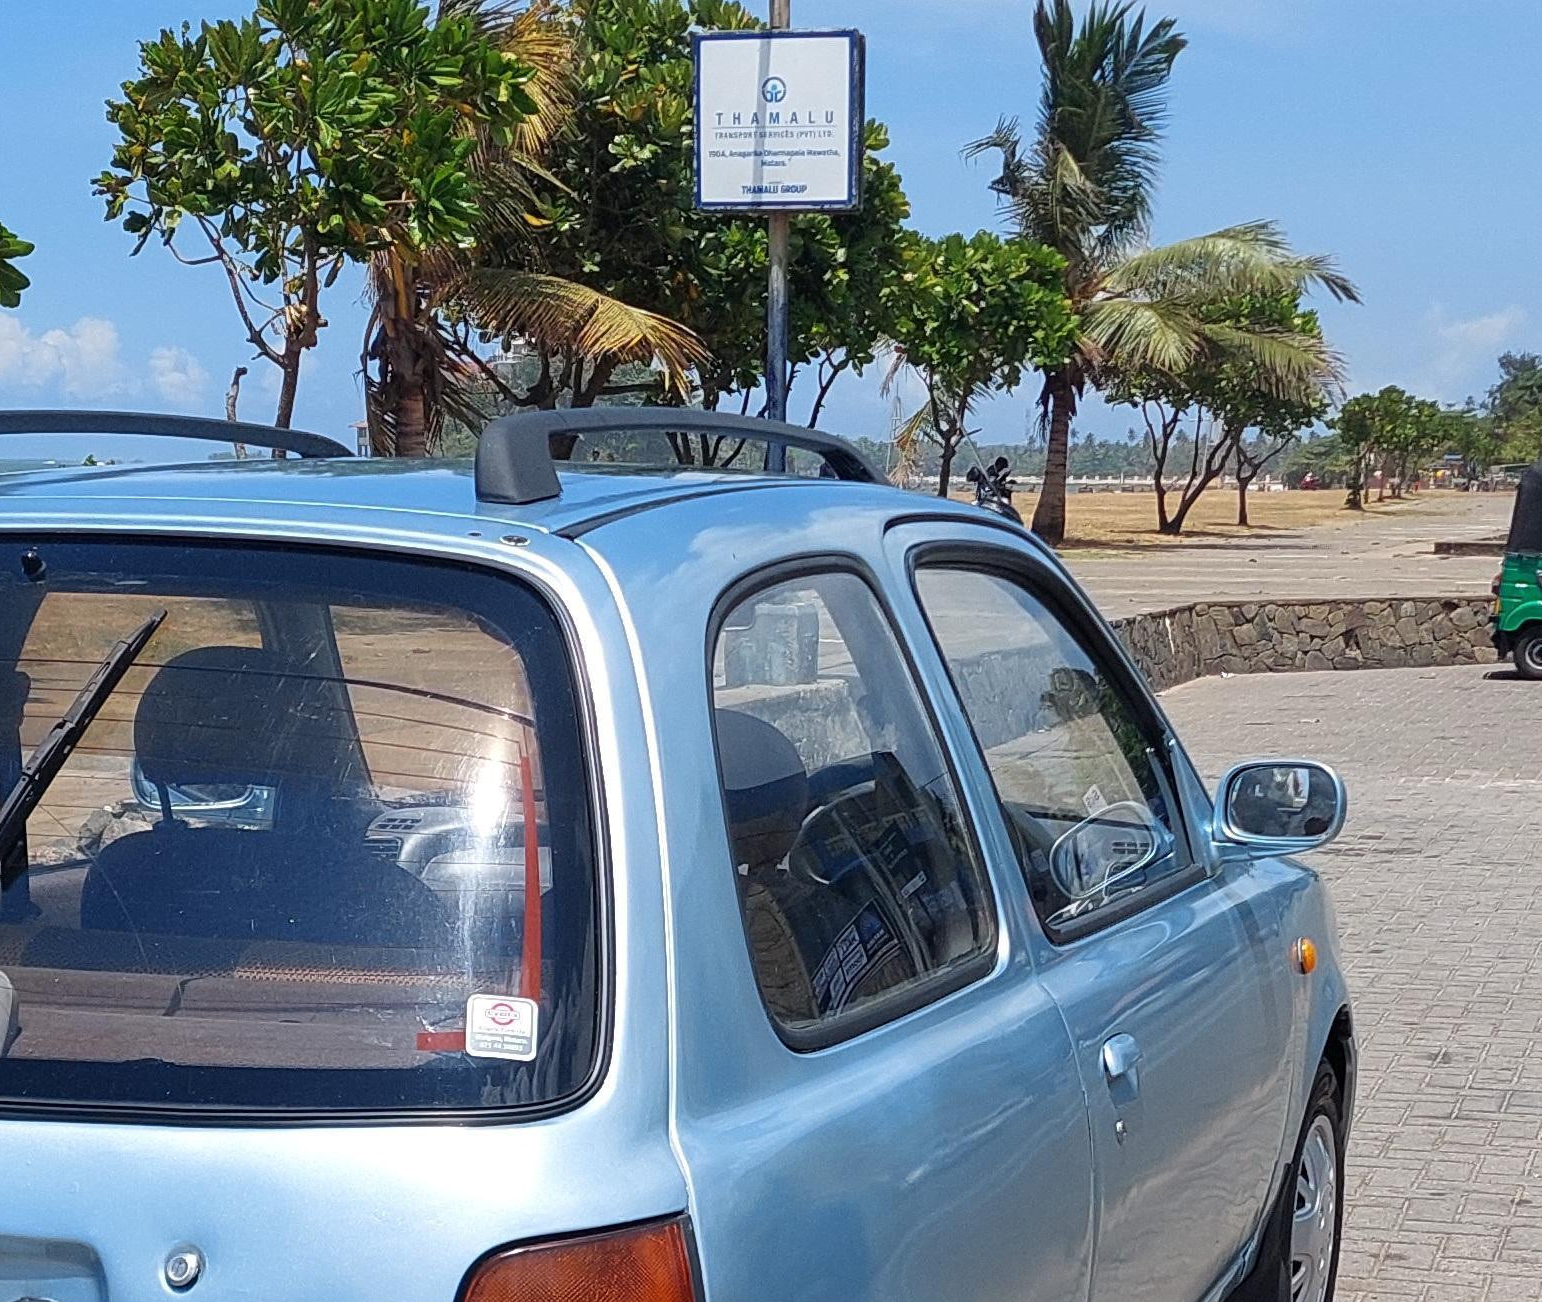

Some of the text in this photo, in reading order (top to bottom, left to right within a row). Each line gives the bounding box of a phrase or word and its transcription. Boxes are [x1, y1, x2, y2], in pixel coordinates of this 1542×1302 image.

[715, 111, 834, 125] THAMALU
[741, 185, 808, 194] THAMALU GROUP
